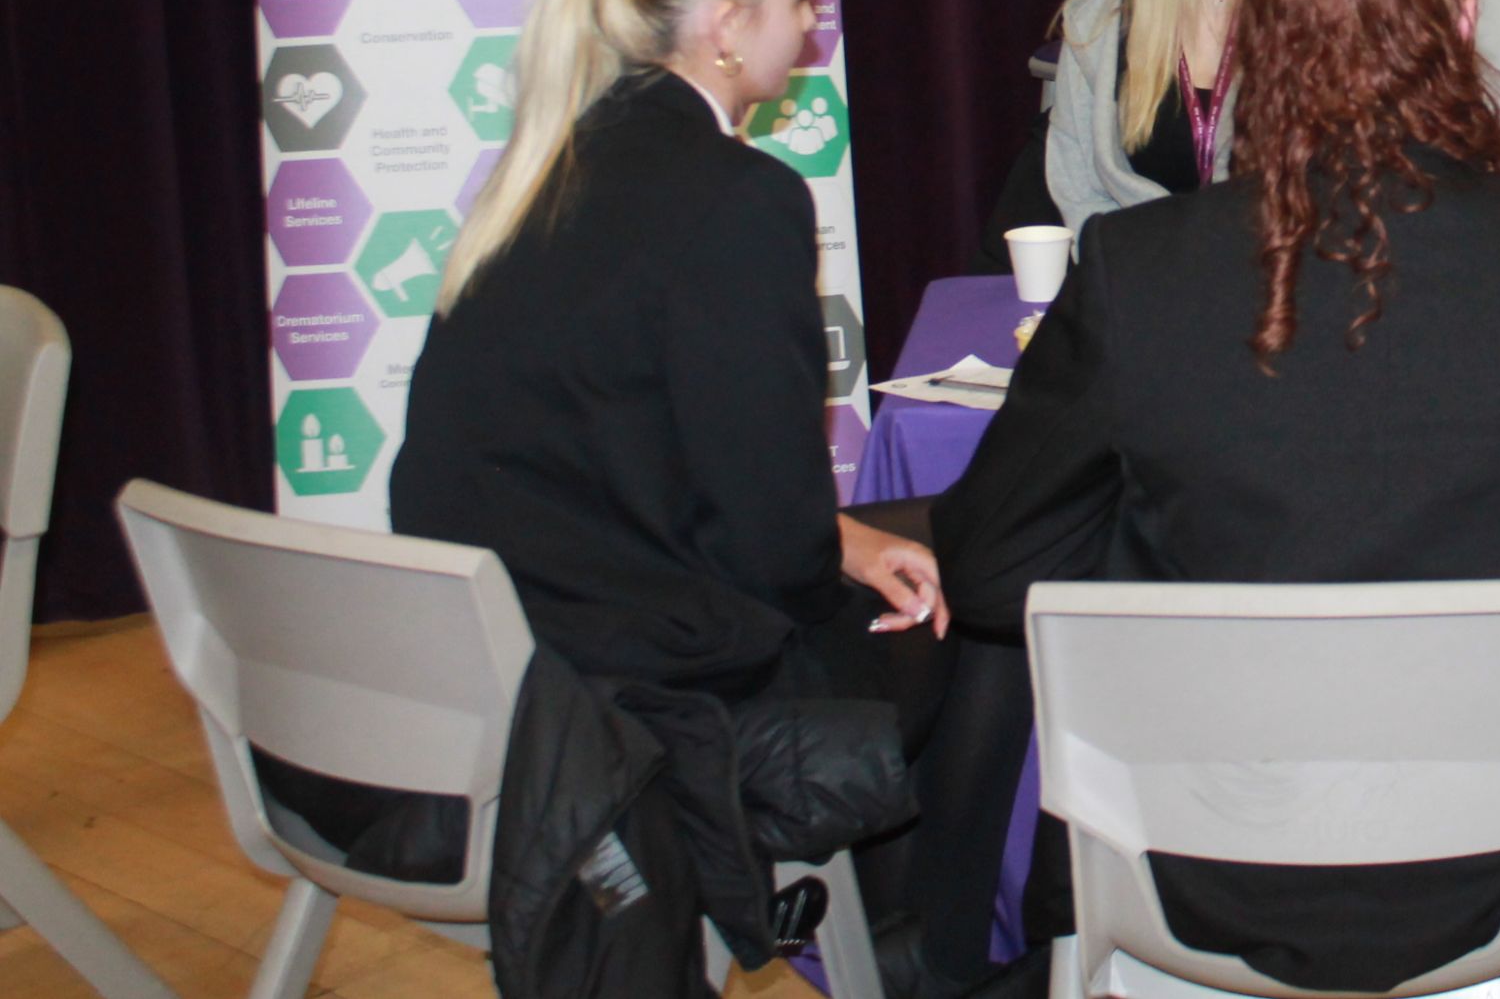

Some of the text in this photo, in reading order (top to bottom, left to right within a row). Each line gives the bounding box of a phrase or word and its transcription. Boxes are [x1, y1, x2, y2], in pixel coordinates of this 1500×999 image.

[361, 30, 453, 44] Conservation
[372, 126, 448, 139] Health and
[371, 143, 450, 157] Community
[375, 160, 448, 173] Protection
[288, 197, 337, 210] Lifeline
[285, 215, 342, 228] Services
[277, 313, 364, 327] Crematorium
[290, 331, 349, 344] Services
